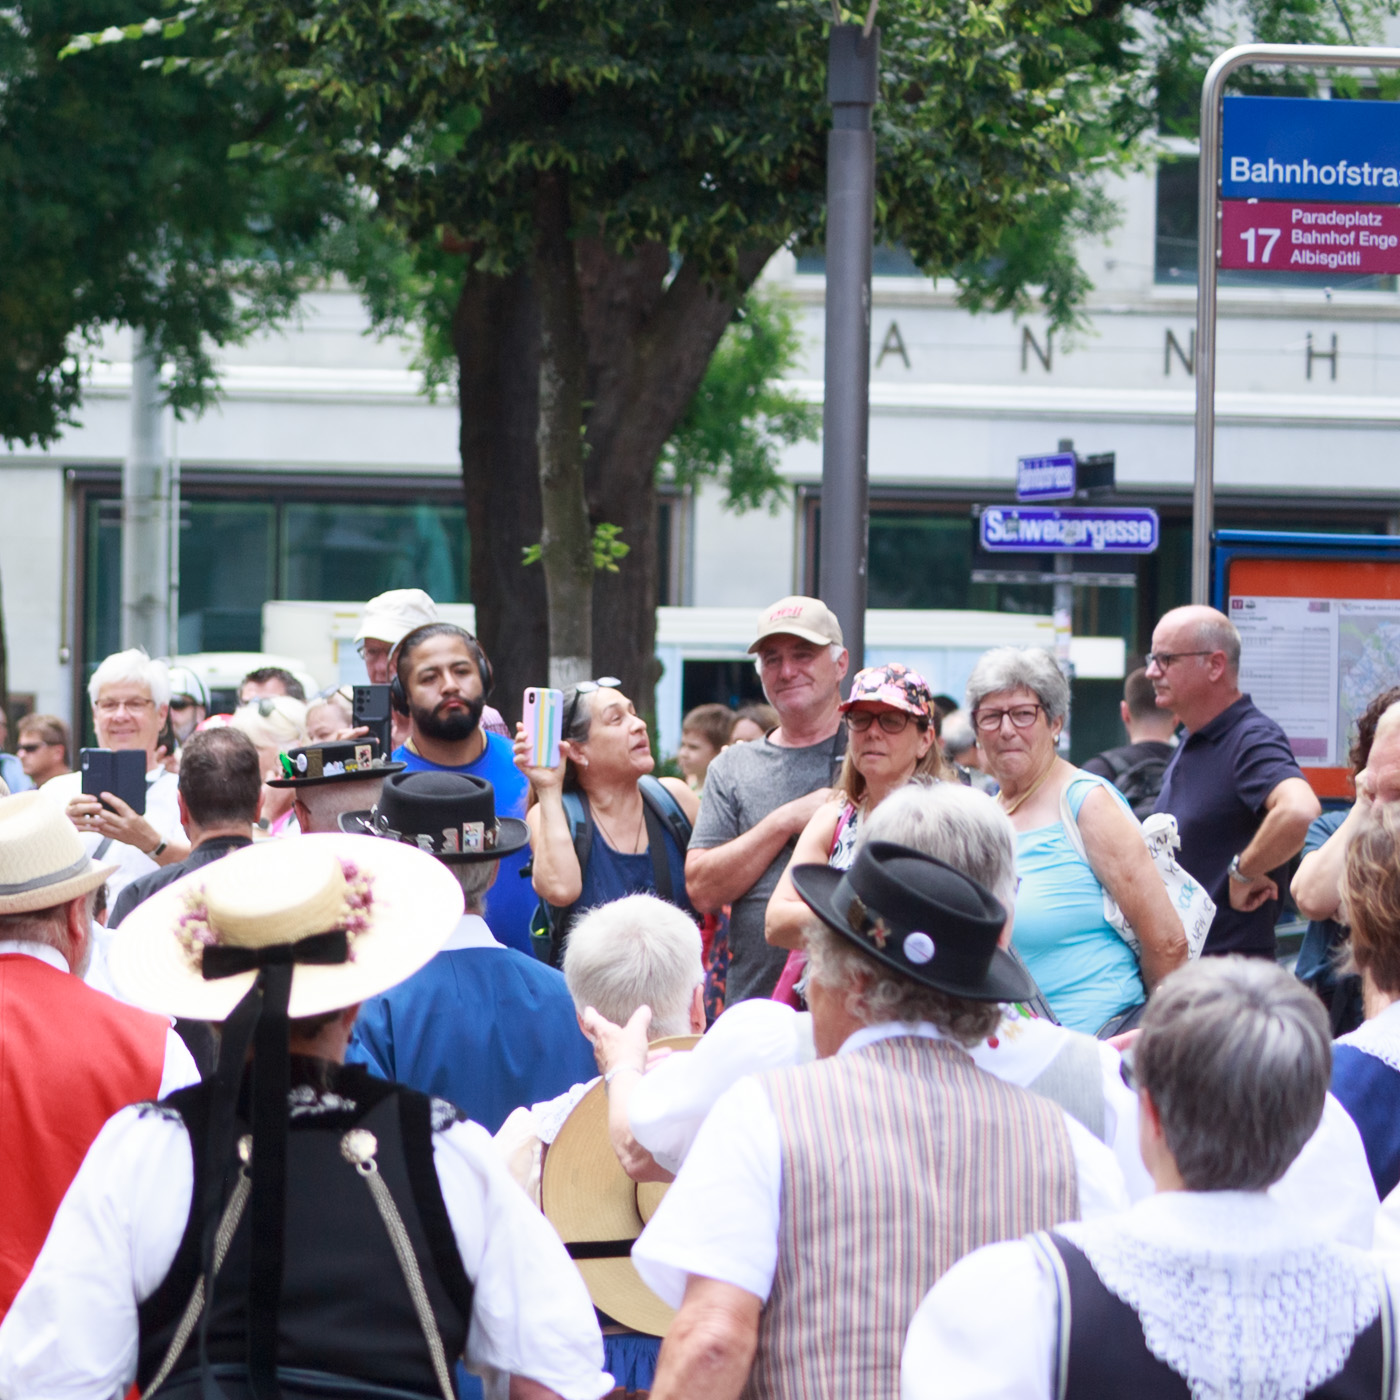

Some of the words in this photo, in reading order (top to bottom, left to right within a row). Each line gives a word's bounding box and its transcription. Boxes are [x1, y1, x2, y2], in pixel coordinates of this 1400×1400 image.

[1230, 156, 1400, 188] Bahnhofstra
[1291, 208, 1383, 229] Paradeplatz
[1239, 227, 1282, 264] 17
[1290, 229, 1356, 246] Bahnhof
[1358, 231, 1399, 250] Enge
[1289, 248, 1361, 269] Albisgütli
